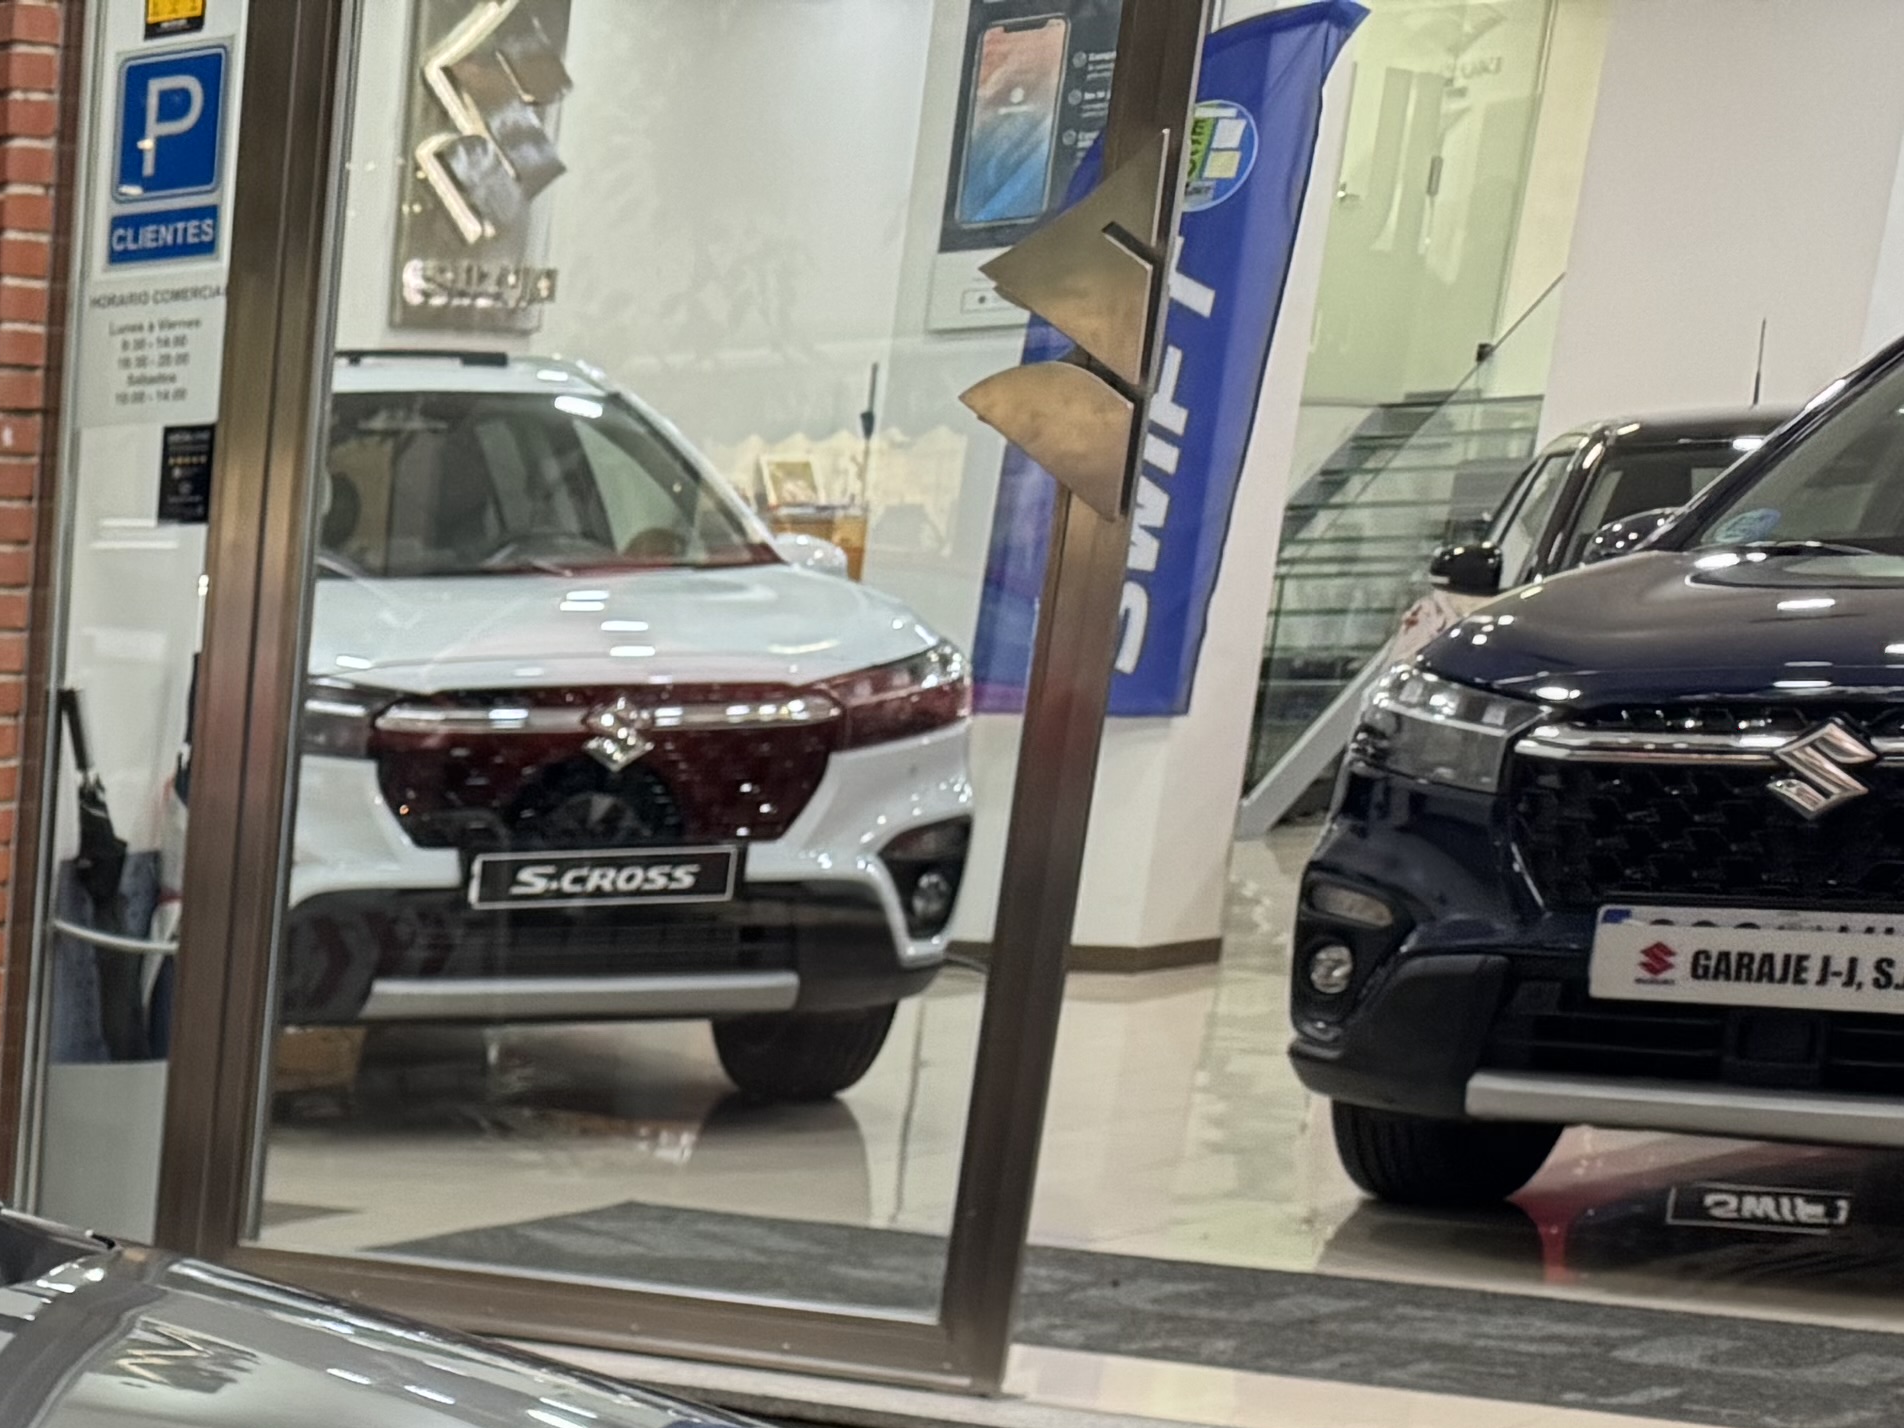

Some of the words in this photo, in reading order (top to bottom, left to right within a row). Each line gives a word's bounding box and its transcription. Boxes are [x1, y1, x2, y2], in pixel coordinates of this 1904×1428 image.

[142, 75, 204, 177] P
[111, 218, 215, 252] CLIENTES
[1690, 949, 1811, 985] GARAJE
[1872, 956, 1904, 991] S.
